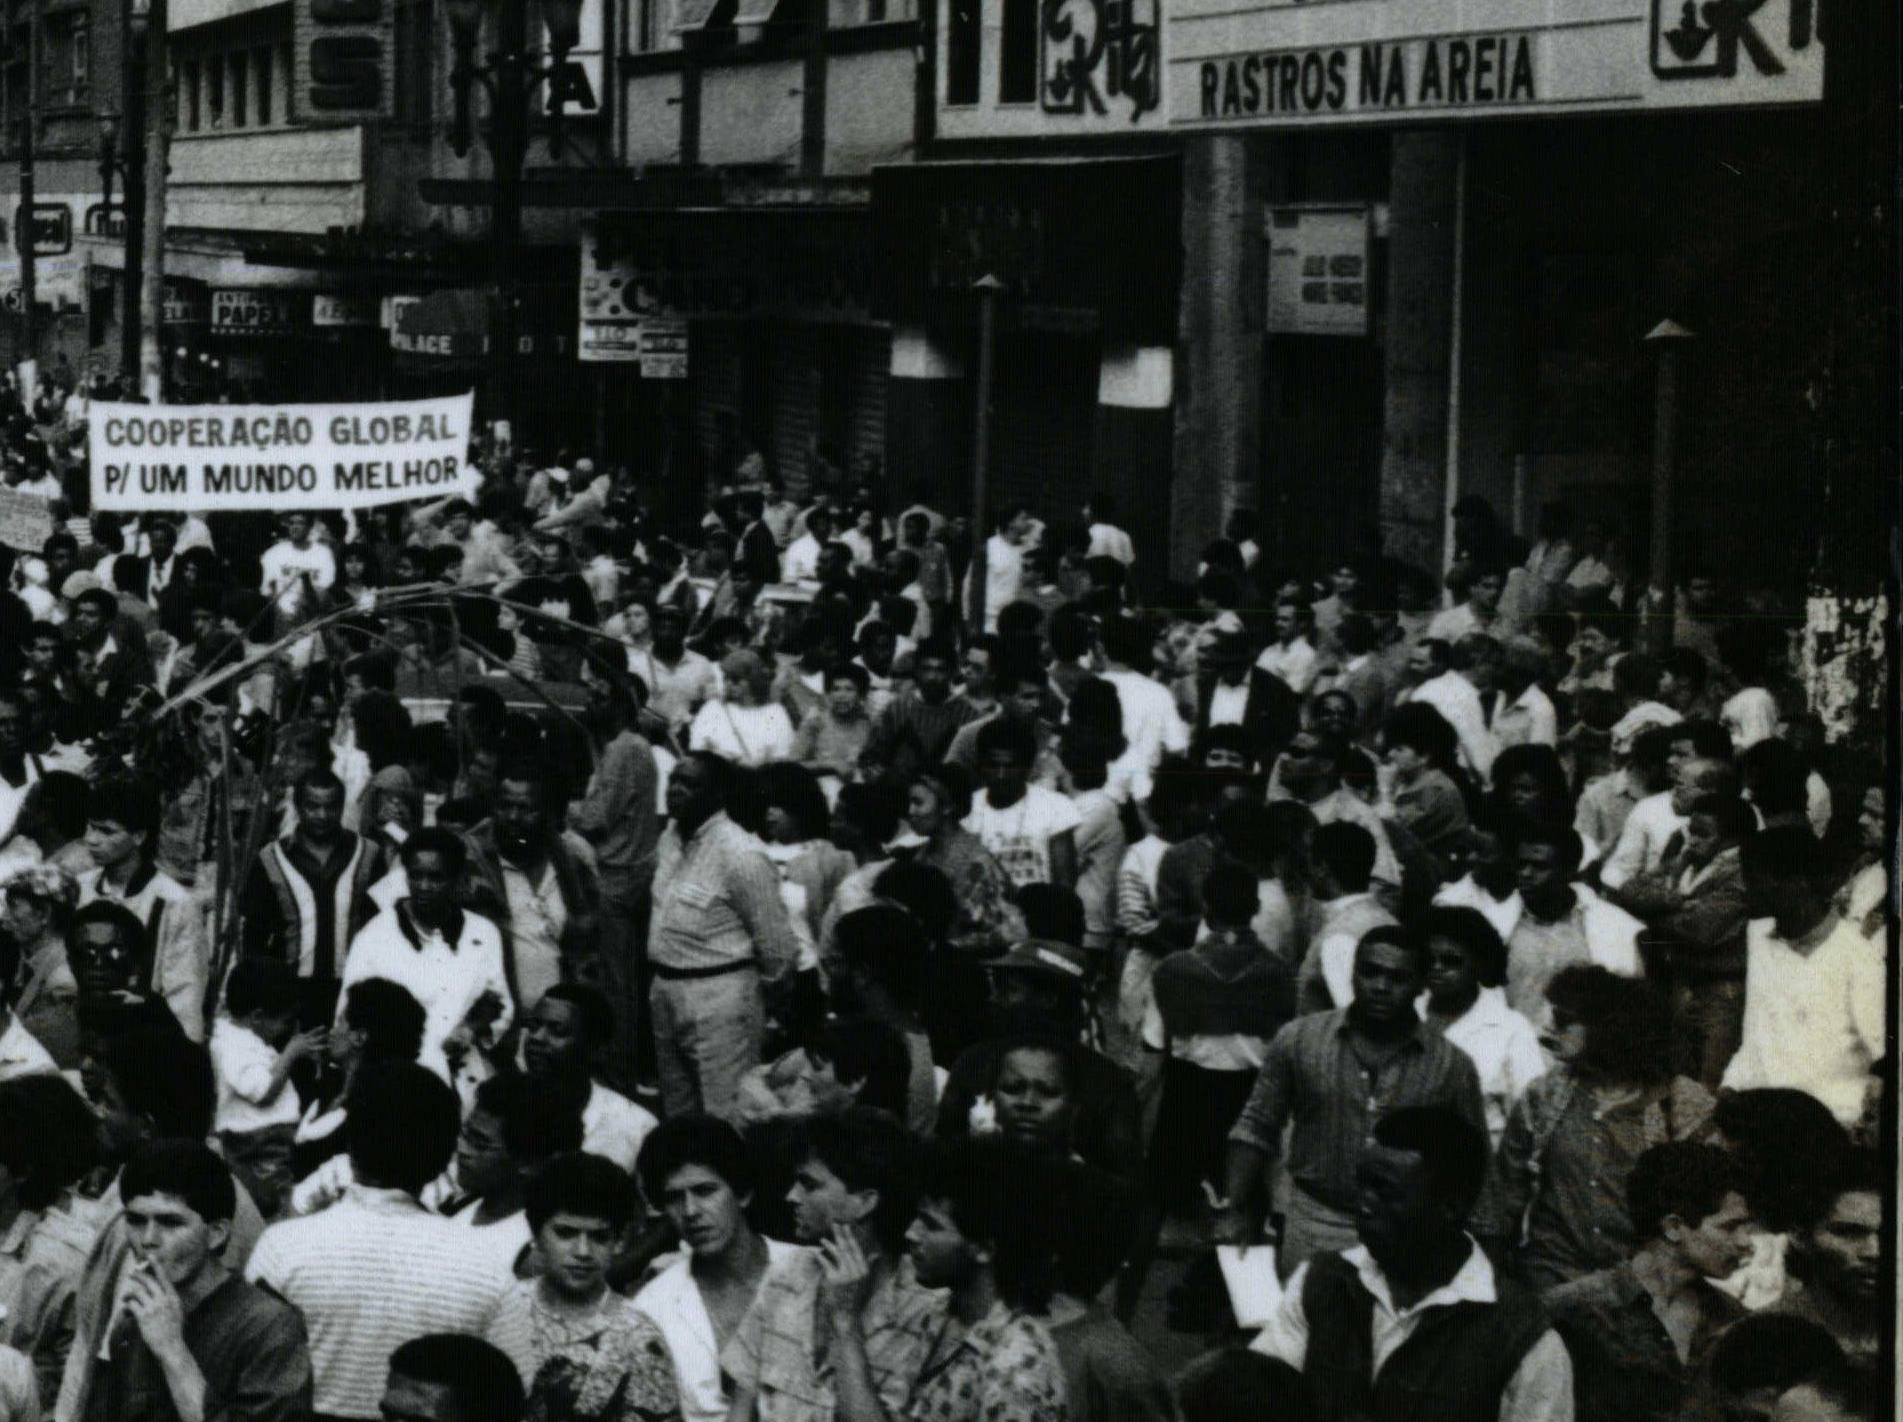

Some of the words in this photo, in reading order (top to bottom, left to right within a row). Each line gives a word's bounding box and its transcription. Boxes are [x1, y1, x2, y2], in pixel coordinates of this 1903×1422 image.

[1202, 50, 1347, 114] RASTROS
[1358, 47, 1406, 105] NA
[1420, 36, 1535, 100] AREIA
[104, 408, 314, 451] COOPERAÇÃO
[329, 408, 458, 447] GLOBAL
[104, 463, 133, 496] P/
[140, 462, 189, 495] UM
[203, 460, 319, 494] MUNDO
[334, 457, 460, 490] MELHOR
